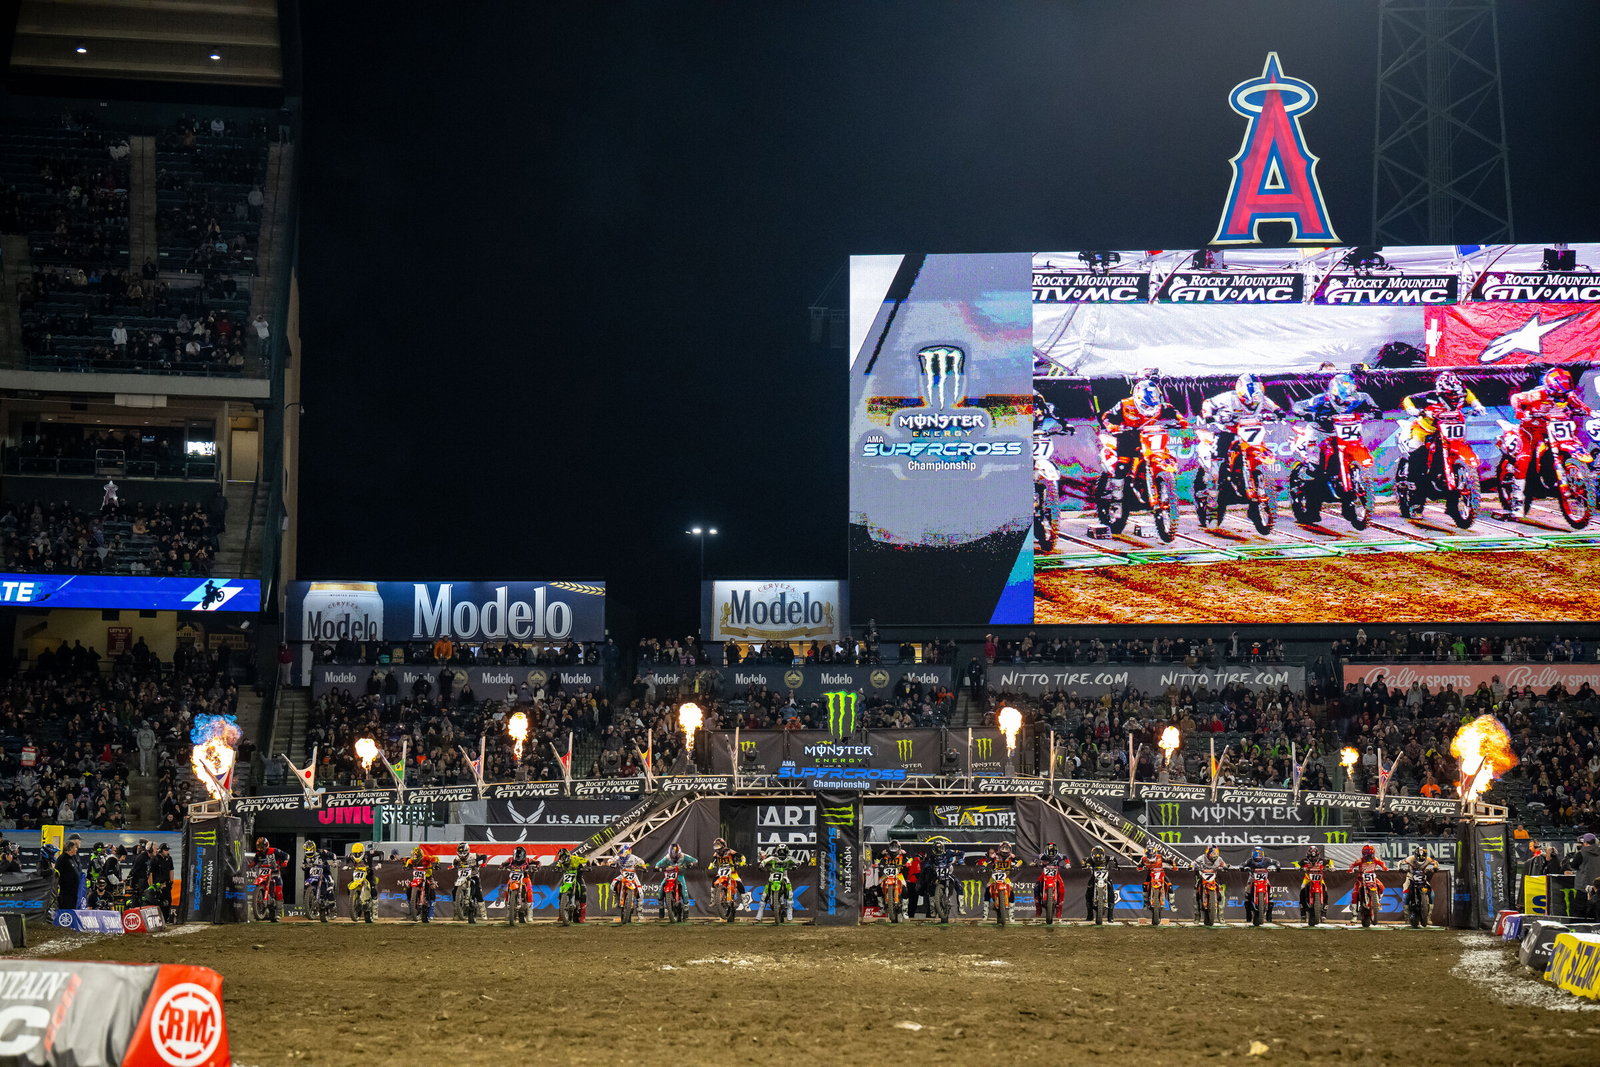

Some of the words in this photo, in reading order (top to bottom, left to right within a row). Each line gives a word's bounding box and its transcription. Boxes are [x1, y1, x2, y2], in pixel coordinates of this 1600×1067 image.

[1074, 276, 1138, 286] MOUNTAIN
[1189, 276, 1230, 286] ROCKY
[1231, 276, 1294, 286] MOUNTAIN
[1347, 278, 1385, 288] ROCKY
[1388, 277, 1449, 288] MOUNTAIN
[1503, 274, 1541, 285] ROCKY
[1243, 428, 1262, 442] 7
[1341, 426, 1361, 440] 94
[1447, 425, 1463, 438] 10
[1554, 423, 1573, 438] 51
[1148, 434, 1163, 450] 1
[862, 443, 1022, 457] SUPERCROSS
[908, 461, 976, 472] Championship
[757, 583, 796, 593] CERVEZA
[412, 583, 573, 639] Modelo
[731, 590, 823, 624] Modelo
[307, 611, 377, 640] Modelo
[325, 671, 356, 684] Modelo
[482, 672, 514, 684] Modelo
[560, 673, 591, 685] Modelo
[735, 673, 766, 685] Modelo
[821, 673, 852, 685] Modelo
[1001, 671, 1049, 686] NITTO
[1054, 671, 1128, 686] TIRE.COM
[1161, 671, 1208, 686] NITTO
[1214, 671, 1289, 686] TIRE.COM
[1364, 666, 1424, 688] Bally
[1426, 675, 1471, 687] SPORTS
[1505, 666, 1566, 688] Bally
[1568, 675, 1600, 687] SPOR
[778, 768, 907, 780] SUPERCROSS
[813, 779, 870, 790] Championship
[1011, 778, 1044, 786] MOUNTAIN
[1069, 781, 1089, 789] ROCKY
[1091, 782, 1125, 790] MOUNTAIN
[1171, 785, 1206, 793] MOUNTAIN
[1232, 789, 1252, 797] ROCKY
[1253, 790, 1288, 798] MOUNTAIN
[266, 796, 299, 804] MOUNTAIN
[1337, 793, 1372, 801] MOUNTAIN
[1421, 799, 1456, 807] MOUNTAIN
[547, 814, 572, 824] U.S.
[576, 814, 600, 824] AIR
[354, 872, 364, 880] 41
[720, 868, 729, 876] 17
[828, 827, 837, 915] SUPERCROSS
[1095, 871, 1107, 879] 27
[1364, 873, 1375, 882] 51
[167, 1007, 214, 1043] RM
